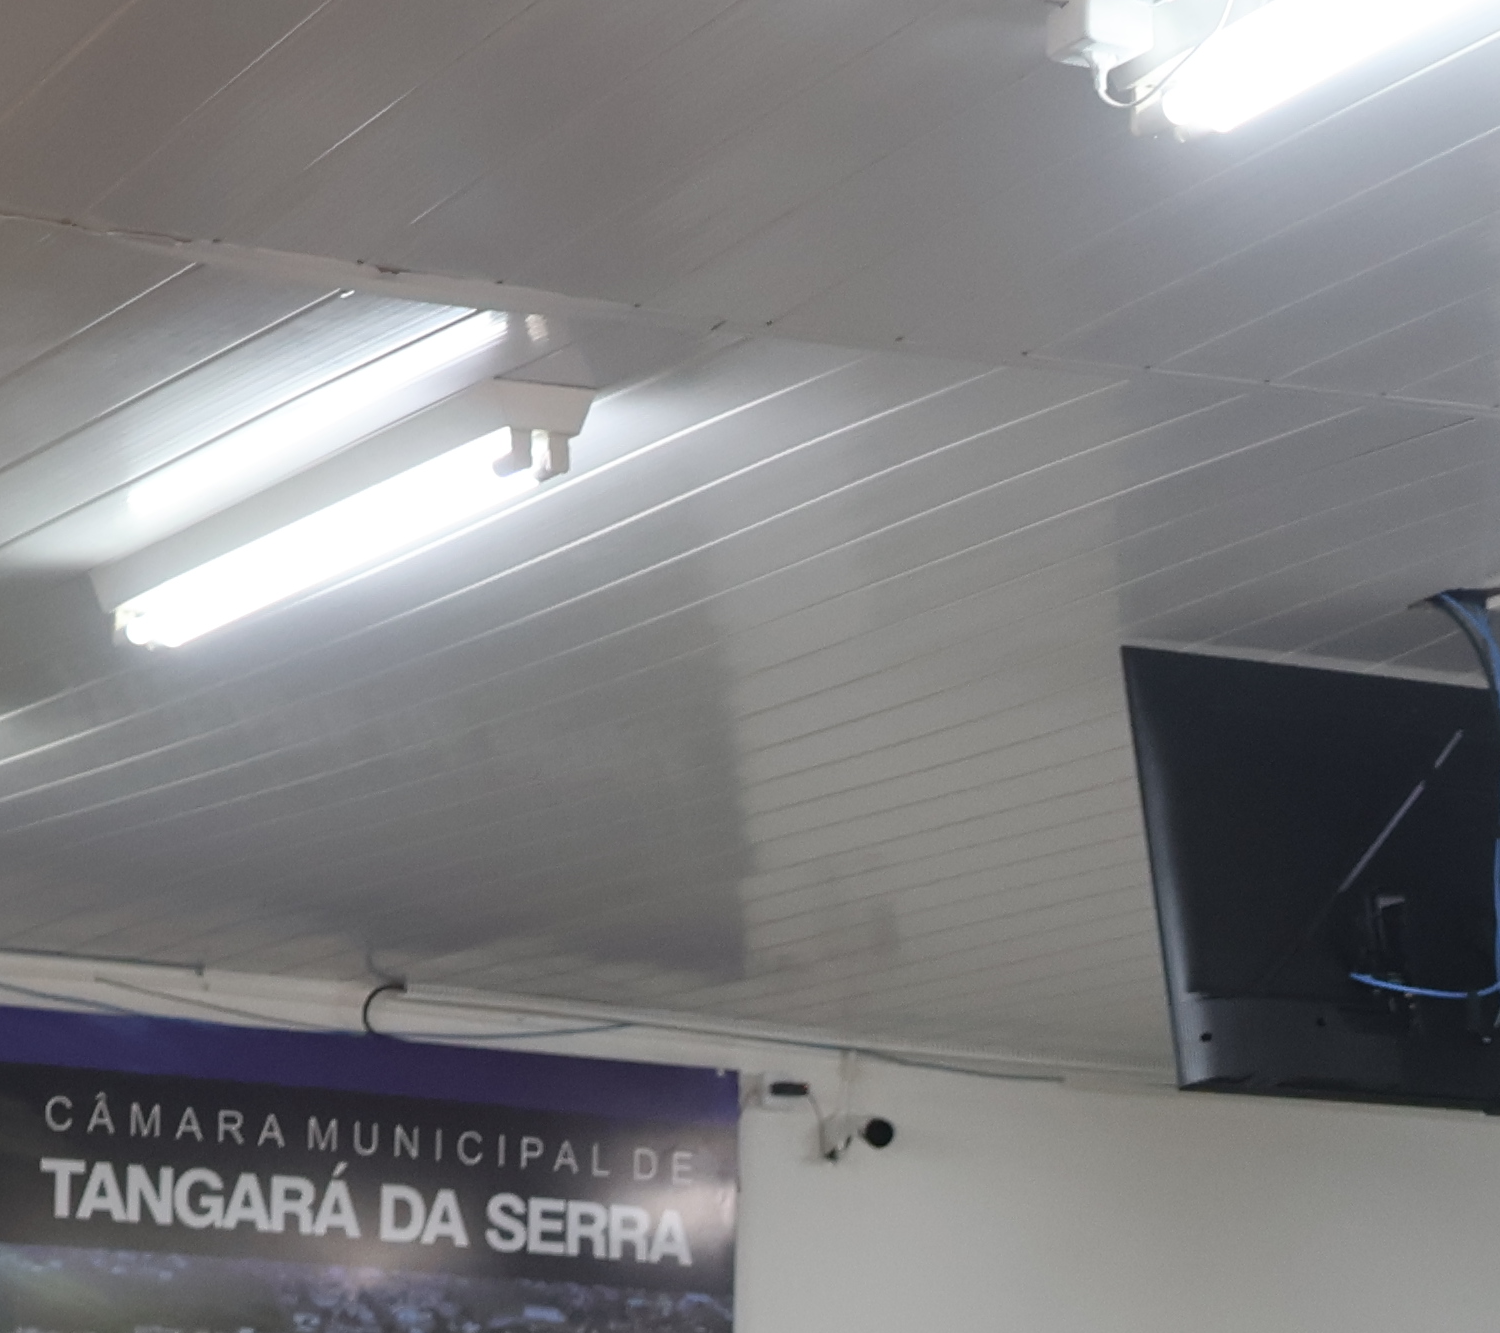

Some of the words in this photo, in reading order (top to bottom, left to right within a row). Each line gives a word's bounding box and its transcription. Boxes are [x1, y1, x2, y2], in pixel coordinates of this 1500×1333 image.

[44, 1091, 286, 1148] CÂMARA
[307, 1115, 611, 1178] MUNICIPAL
[632, 1146, 694, 1187] DE
[39, 1156, 362, 1240] TANGARÁ
[379, 1182, 470, 1248] DA
[484, 1191, 694, 1268] SERRA
